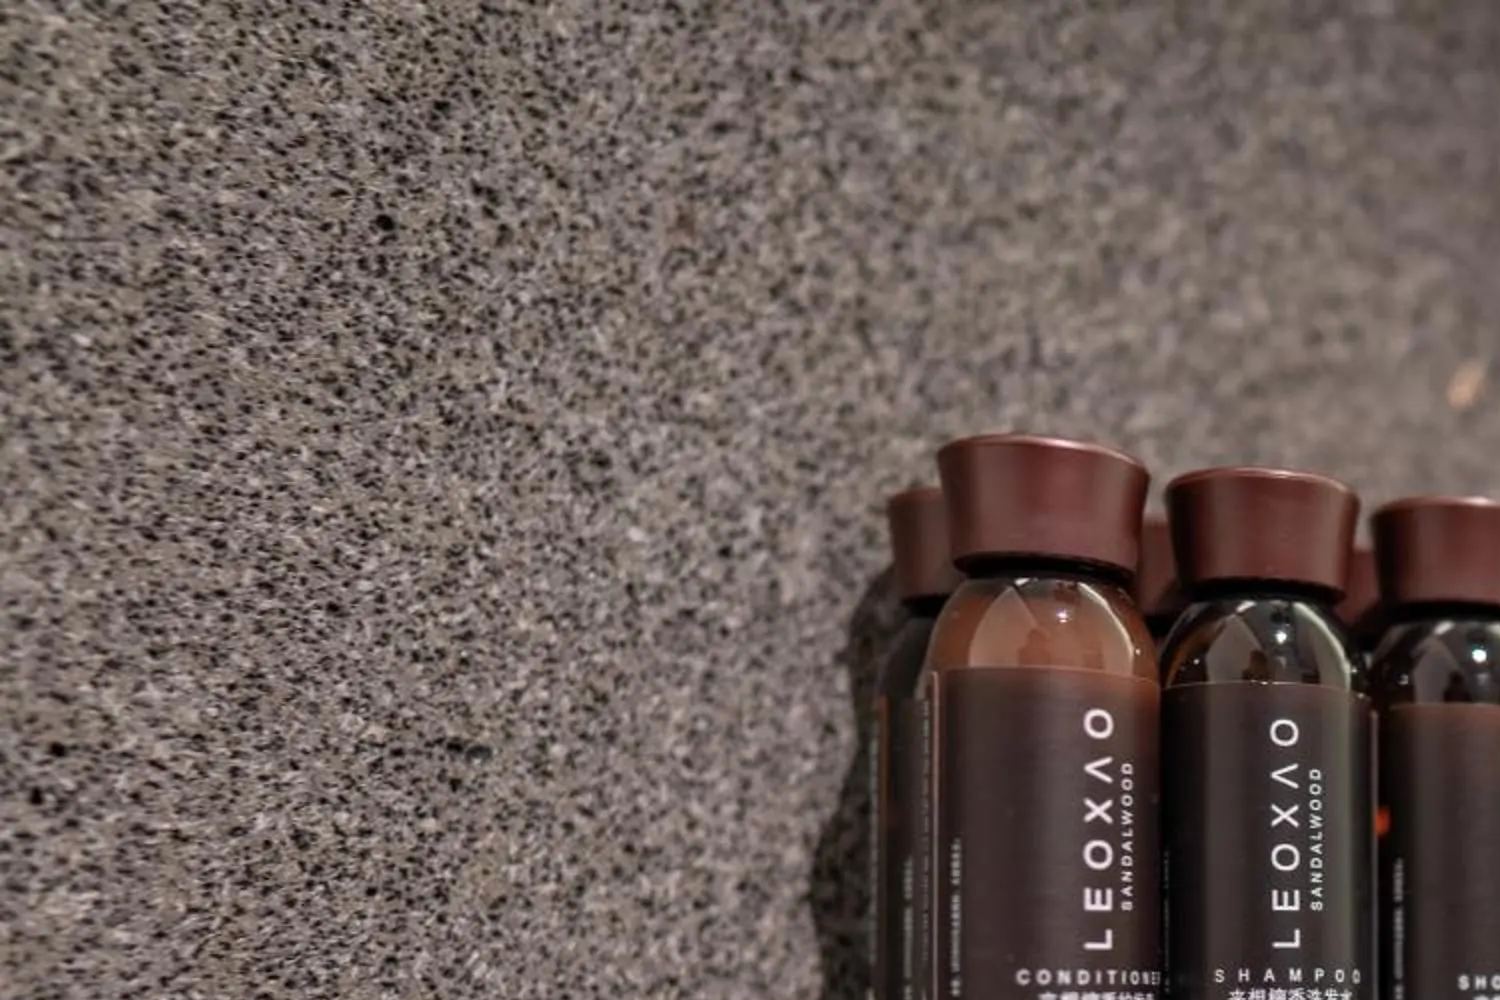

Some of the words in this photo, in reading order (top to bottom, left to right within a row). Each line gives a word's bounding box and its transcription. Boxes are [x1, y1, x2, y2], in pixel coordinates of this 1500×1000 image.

[1120, 762, 1134, 911] SANDALWOOD
[1309, 768, 1324, 911] SANDALWOOD
[1016, 968, 1161, 986] CONDITIONE
[1215, 967, 1361, 984] SHAMPOO
